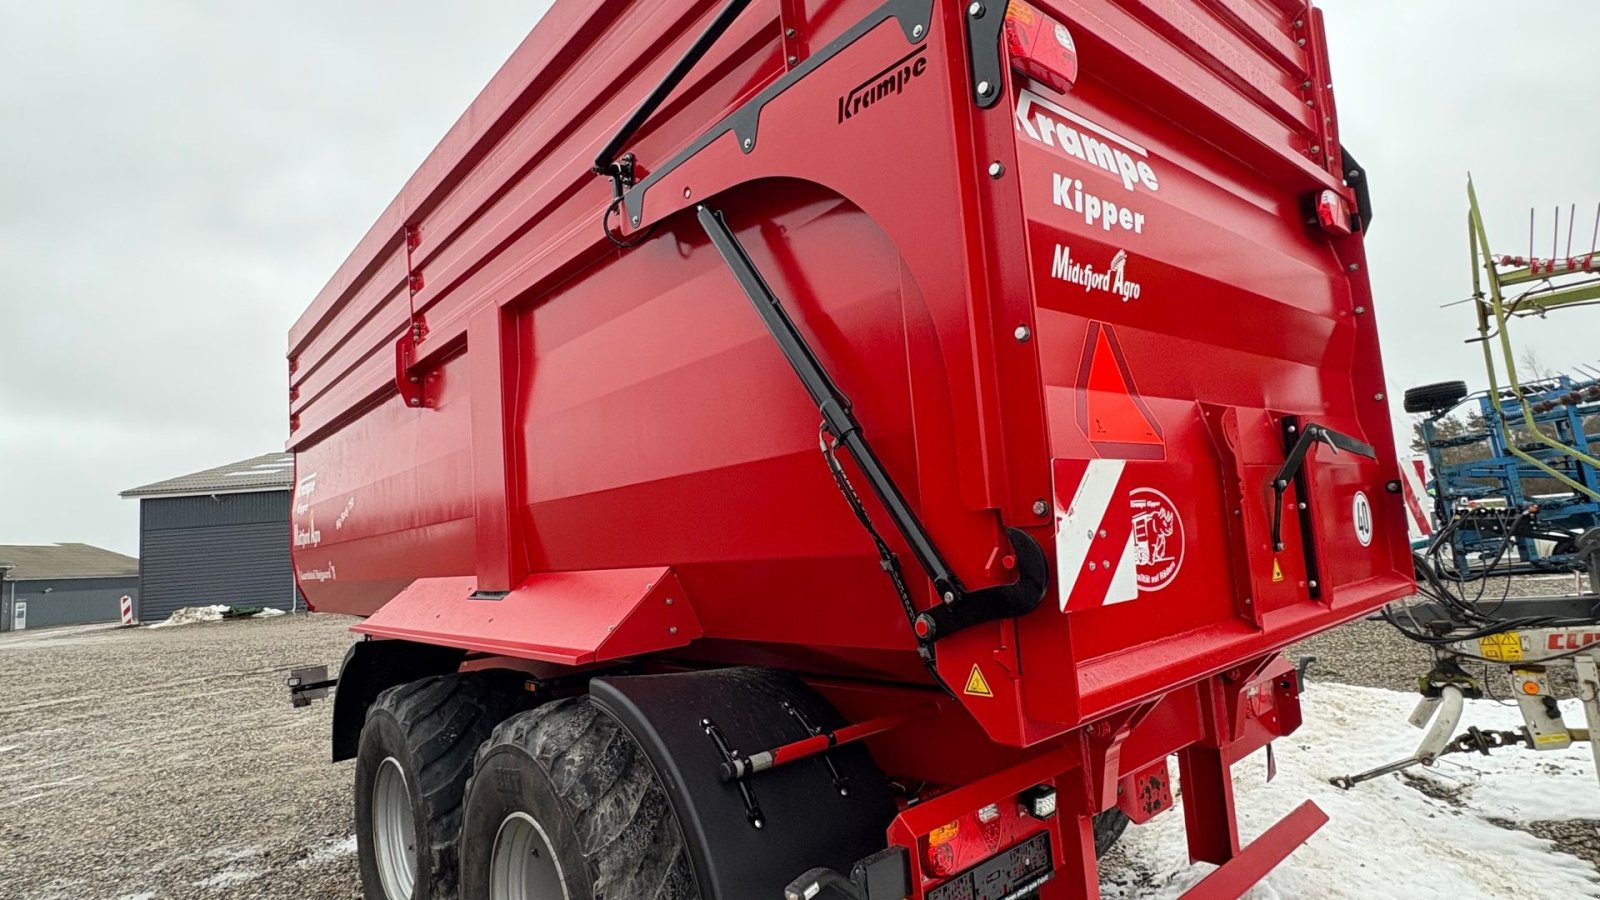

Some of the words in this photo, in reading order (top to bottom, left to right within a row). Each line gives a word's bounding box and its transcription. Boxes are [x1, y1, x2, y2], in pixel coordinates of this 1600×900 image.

[837, 43, 928, 125] Krampe
[1014, 87, 1160, 192] Krampe
[1052, 172, 1145, 234] Kipper
[1051, 243, 1111, 293] Midtfjord
[1111, 251, 1141, 302] Agro
[1356, 501, 1370, 535] 40
